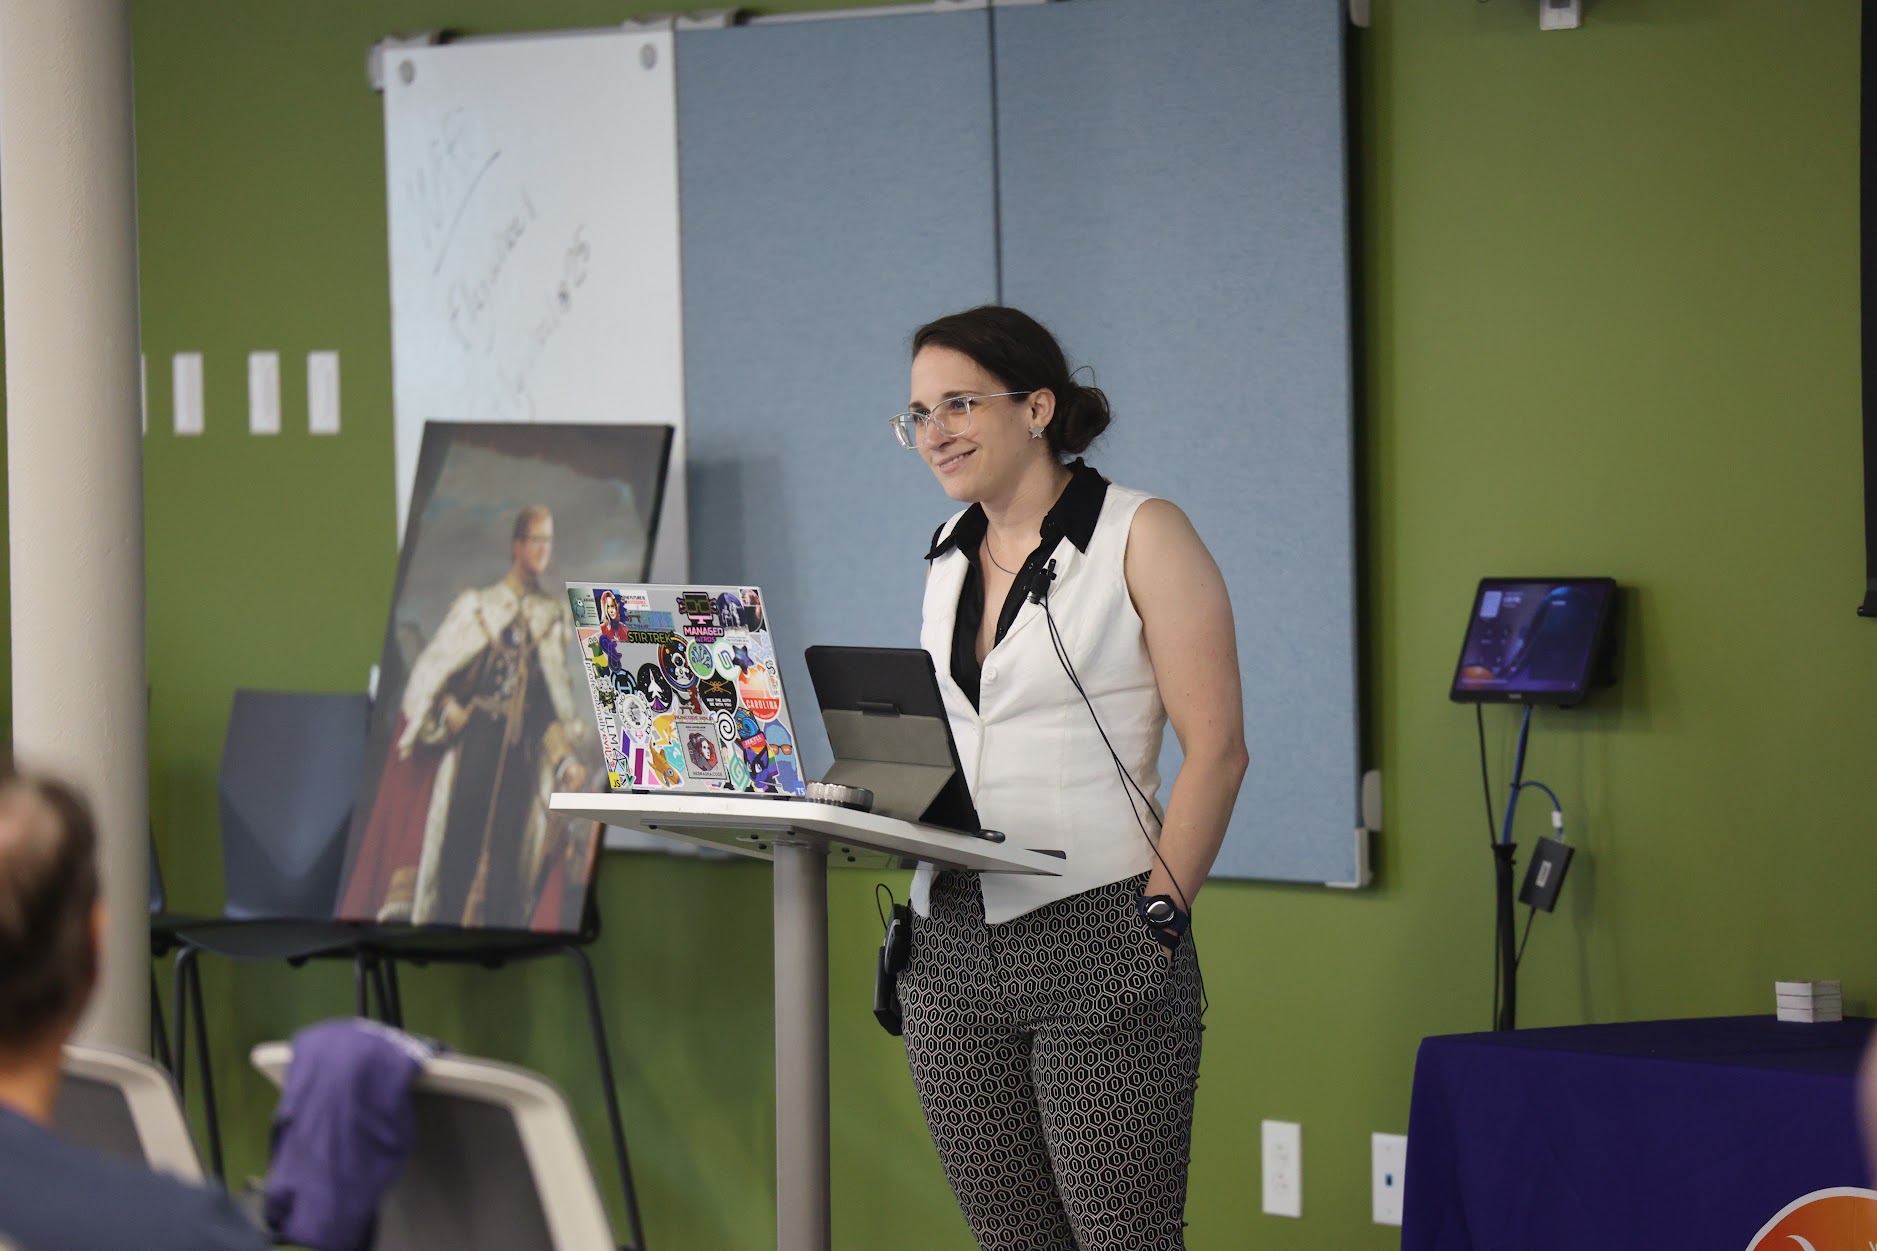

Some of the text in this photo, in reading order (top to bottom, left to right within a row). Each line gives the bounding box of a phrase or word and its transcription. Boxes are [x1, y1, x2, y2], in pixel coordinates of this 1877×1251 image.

[683, 626, 724, 636] MANAGED
[745, 699, 778, 710] CAROLINA
[614, 779, 621, 788] JS
[796, 787, 806, 796] TS
